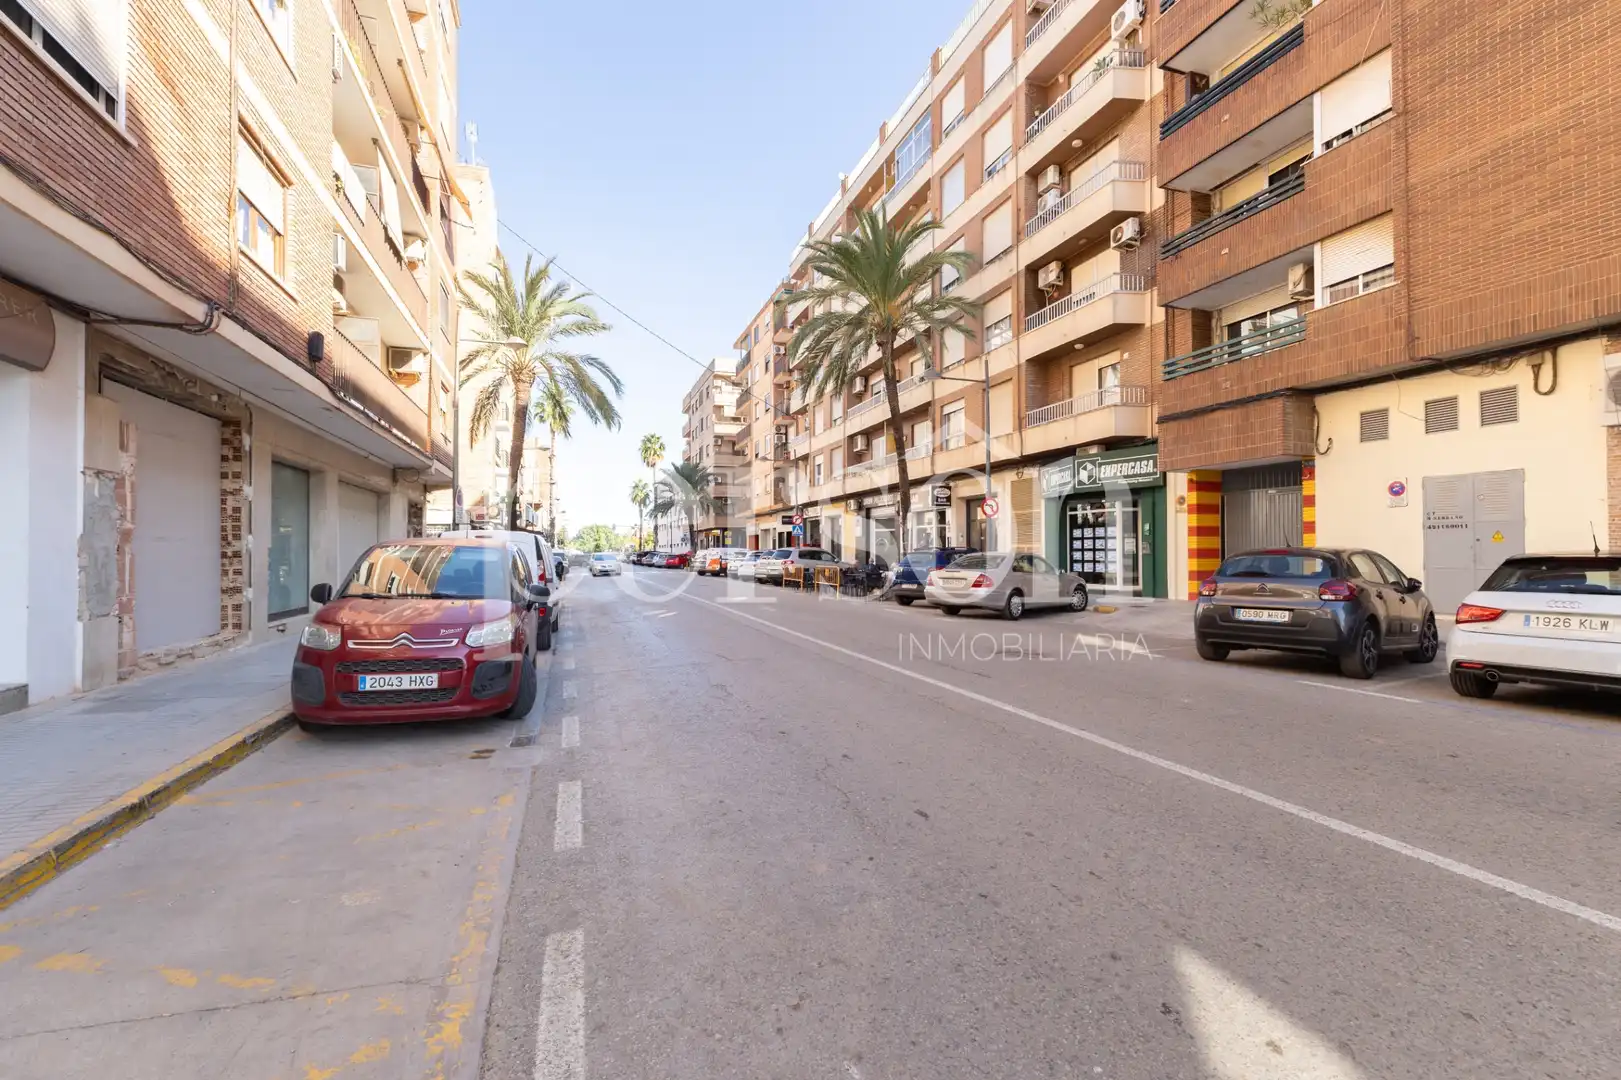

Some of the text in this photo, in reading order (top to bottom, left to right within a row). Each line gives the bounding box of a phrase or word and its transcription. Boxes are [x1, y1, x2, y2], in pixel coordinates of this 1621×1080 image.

[1100, 459, 1154, 478] EXPERCASA
[1241, 609, 1287, 619] 0590 MRG
[1535, 616, 1609, 631] 1926 KLW
[369, 675, 434, 689] 2043 HXG
